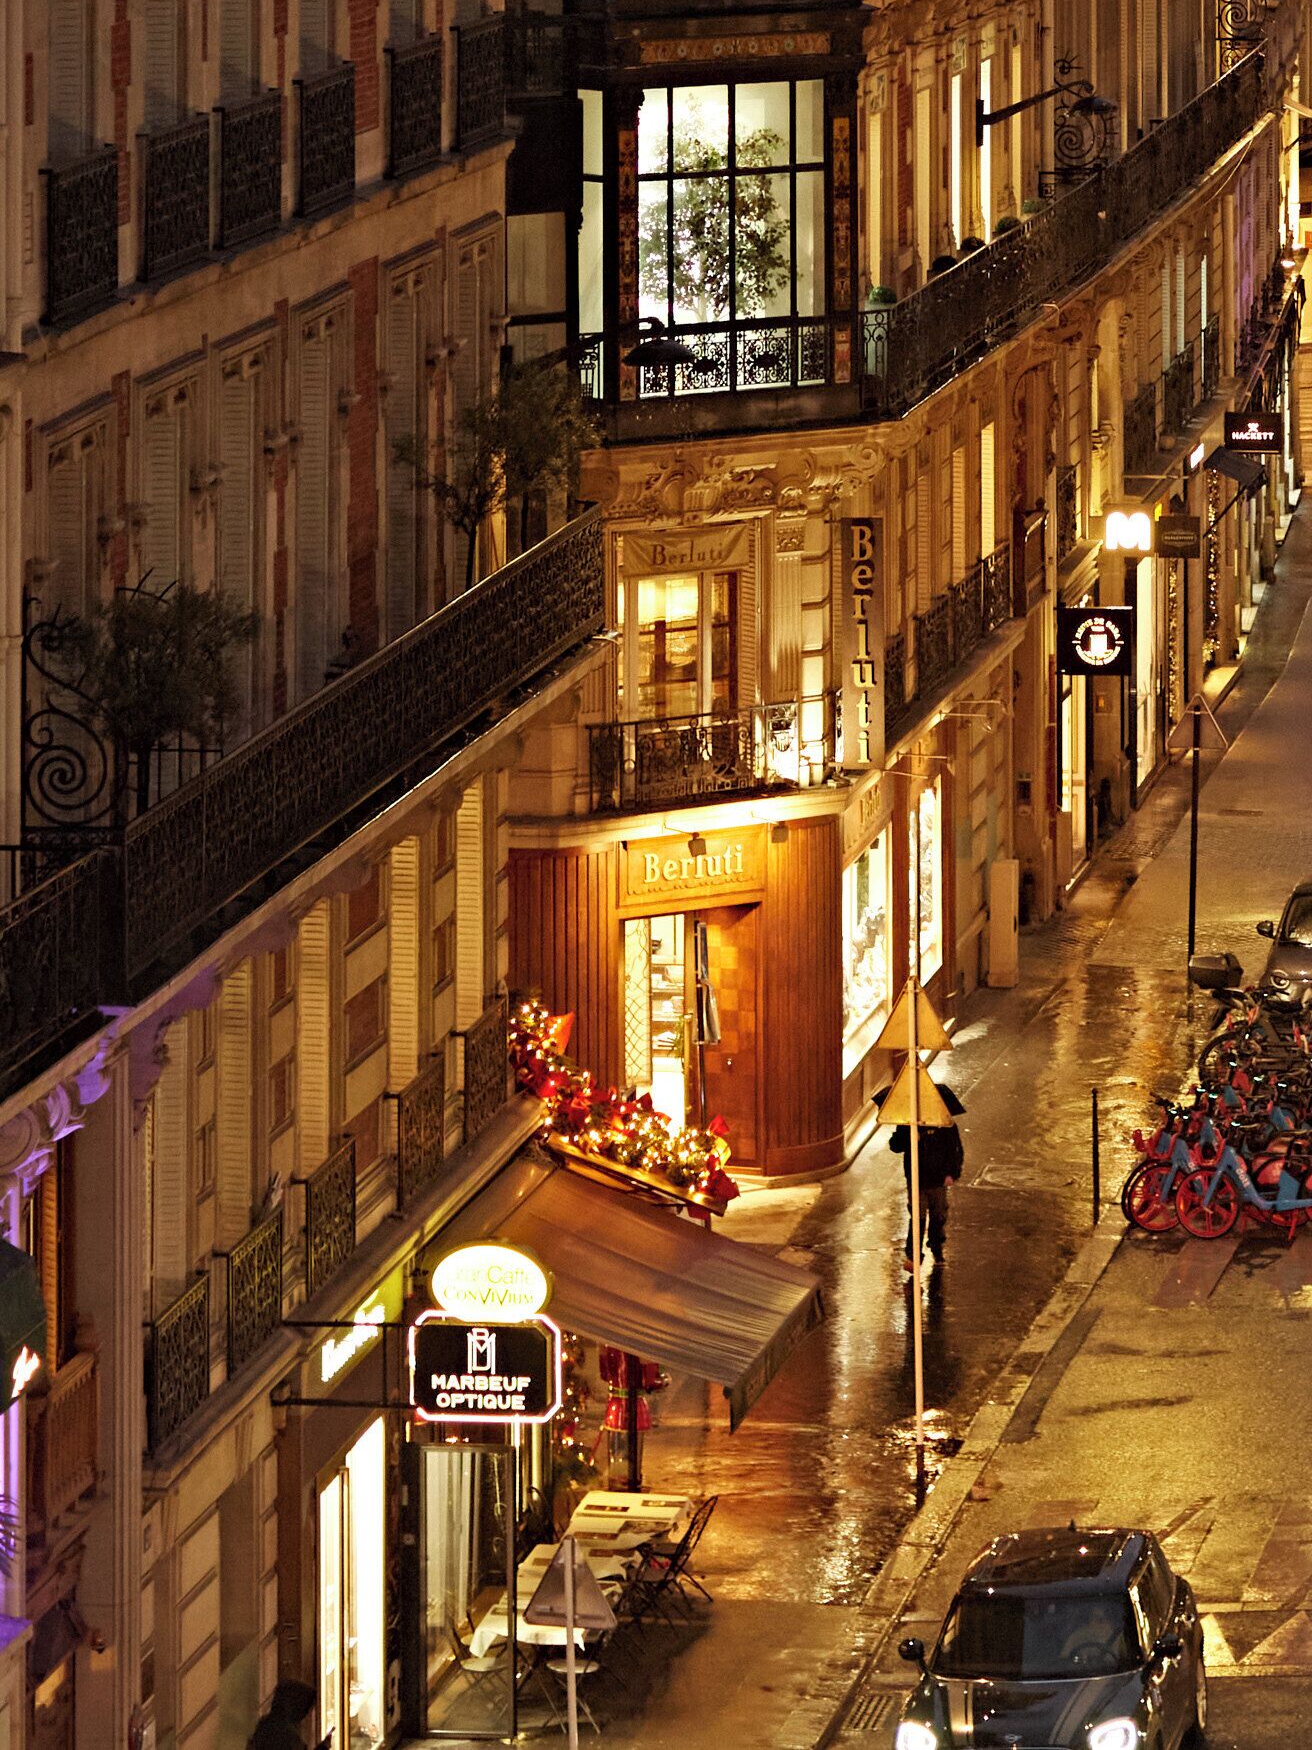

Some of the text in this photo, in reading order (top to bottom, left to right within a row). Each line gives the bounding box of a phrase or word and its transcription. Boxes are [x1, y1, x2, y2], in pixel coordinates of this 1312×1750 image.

[1231, 432, 1275, 441] HACKETT
[650, 539, 723, 566] Berluti
[851, 525, 877, 763] Berluti
[643, 844, 744, 884] Berluti
[431, 1374, 531, 1392] MARBEUF
[436, 1393, 526, 1410] OPTIQUE
